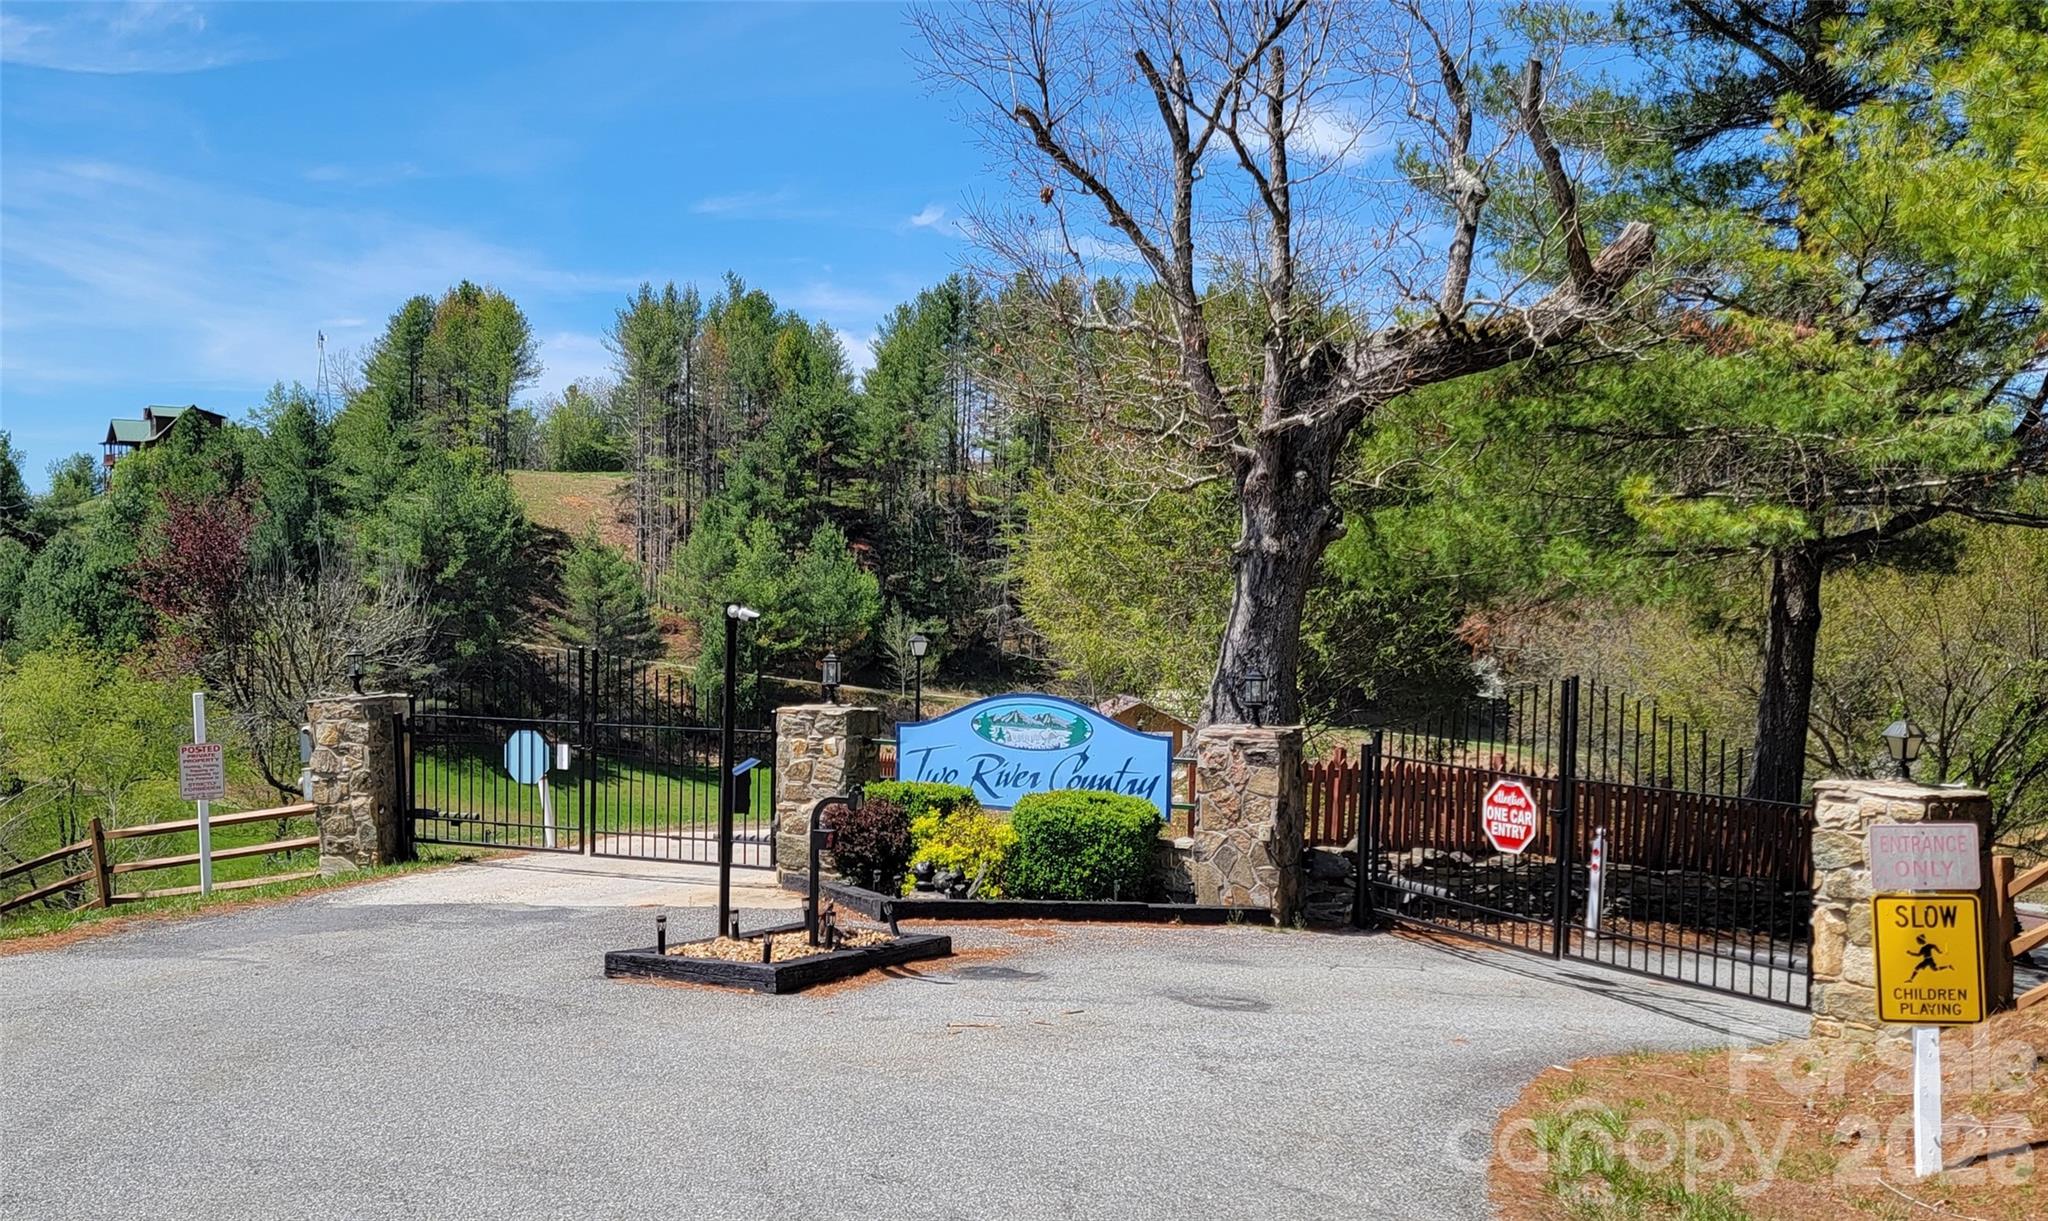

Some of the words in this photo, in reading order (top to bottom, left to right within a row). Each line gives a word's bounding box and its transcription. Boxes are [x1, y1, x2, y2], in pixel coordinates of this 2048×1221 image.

[181, 745, 220, 754] POSTED
[905, 744, 958, 783] Two
[966, 753, 1041, 799] River
[1050, 744, 1162, 799] Country
[1487, 806, 1509, 822] ONE
[1509, 808, 1533, 827] CAR
[1491, 821, 1527, 840] ENTRY
[1880, 835, 1967, 853] ENTRANCE
[1894, 860, 1954, 877] ONLY
[1895, 905, 1957, 928] SLOW
[1893, 988, 1967, 1001] CHILDREN
[1900, 1003, 1962, 1015] PLAYING
